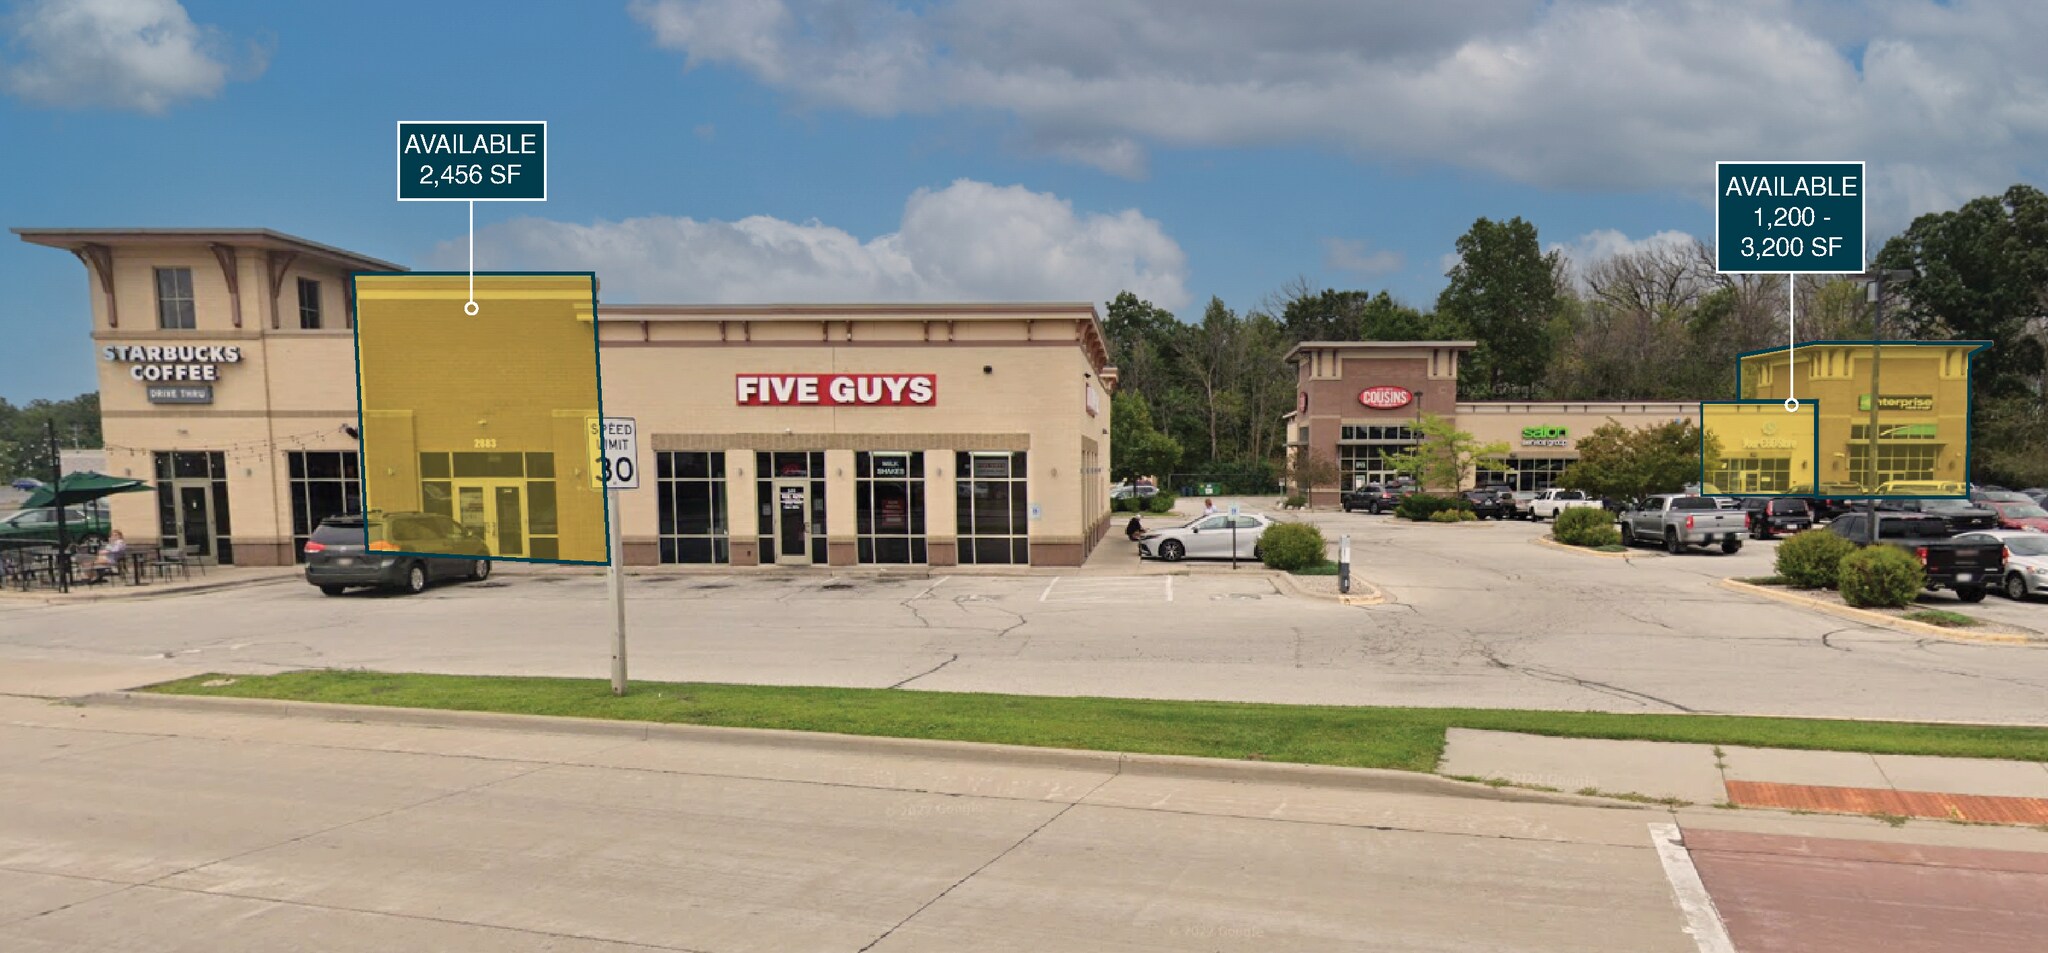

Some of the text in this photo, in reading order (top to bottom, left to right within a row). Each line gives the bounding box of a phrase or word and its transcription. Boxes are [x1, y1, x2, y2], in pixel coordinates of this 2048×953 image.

[104, 346, 242, 362] STARBUCKS
[131, 365, 218, 381] COFFEE
[151, 388, 206, 399] DRIVE THRU
[738, 377, 933, 404] FIVE GUYS
[1363, 391, 1408, 404] COUSINS
[1873, 398, 1933, 409] nterprise
[1522, 426, 1568, 439] salon
[596, 457, 634, 482] 30
